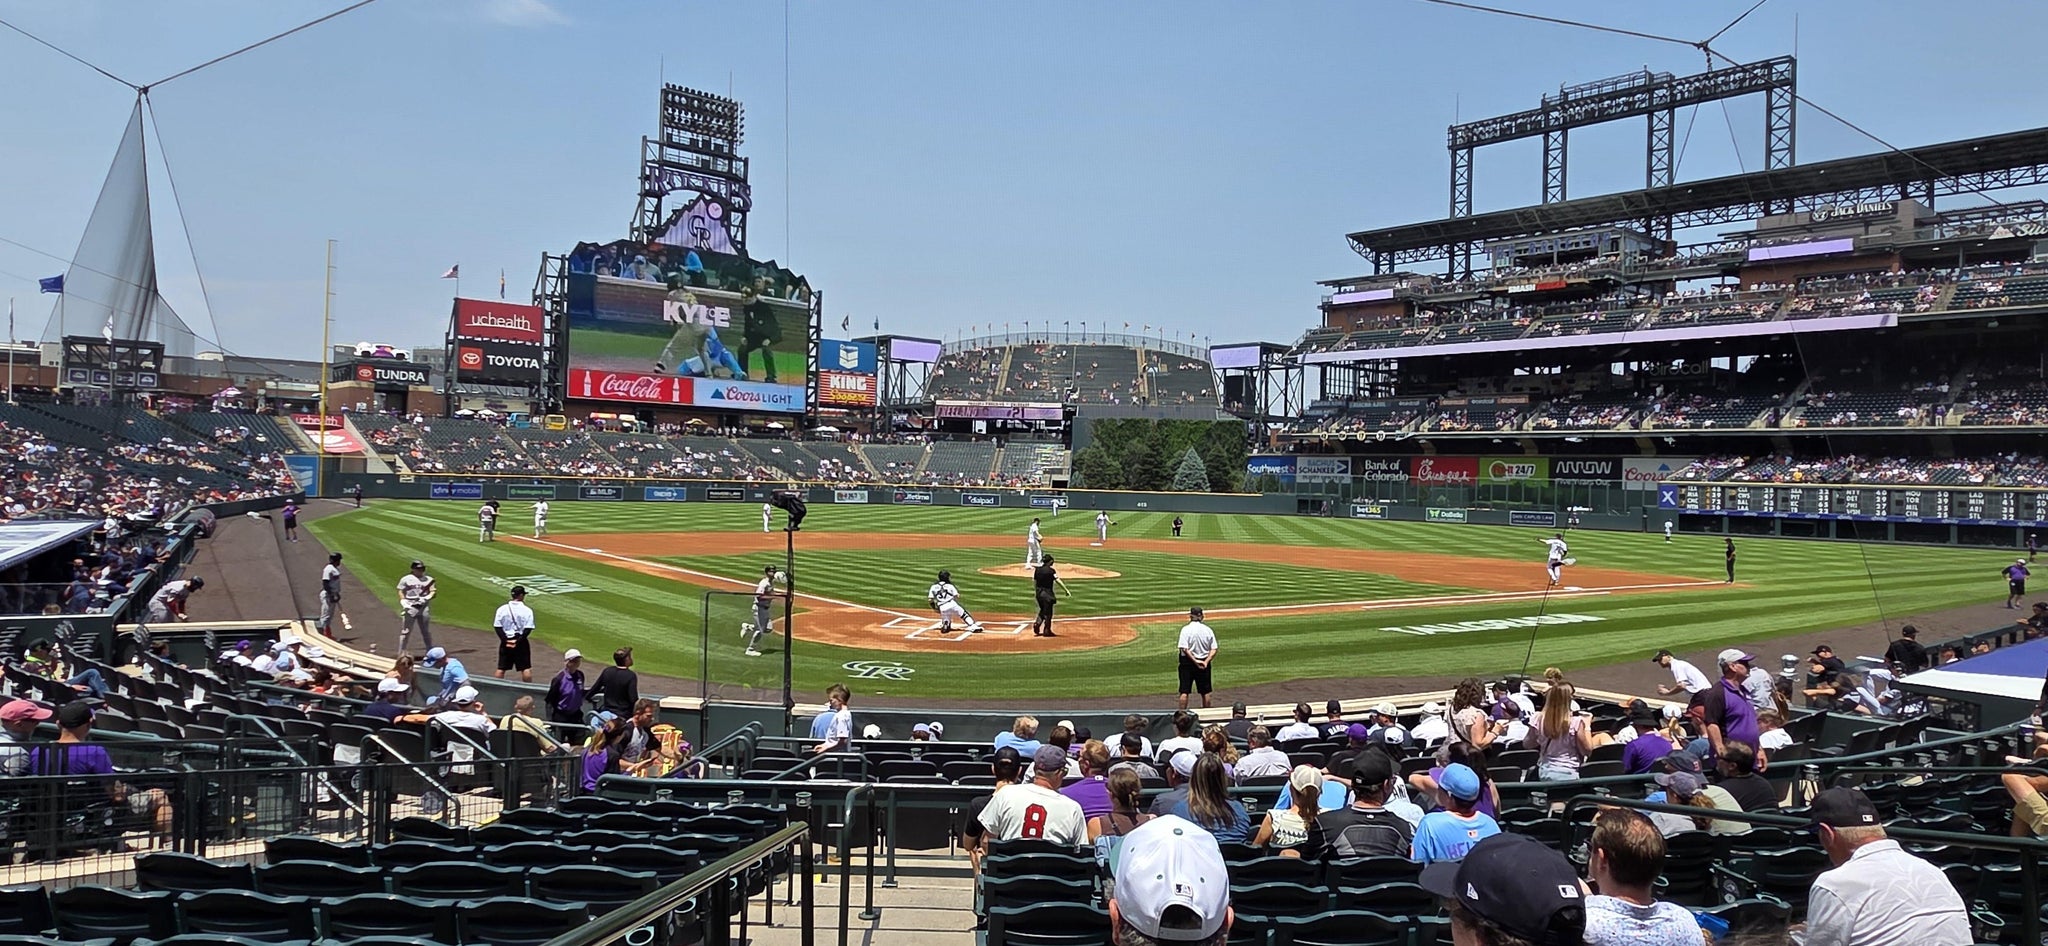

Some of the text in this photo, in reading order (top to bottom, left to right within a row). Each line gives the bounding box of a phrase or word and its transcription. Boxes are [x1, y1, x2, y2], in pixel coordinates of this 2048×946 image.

[1831, 206, 1854, 217] JACK
[663, 301, 730, 327] KYLE
[472, 312, 531, 331] uchealth
[486, 354, 540, 369] TOYOTA
[374, 368, 425, 382] TUNDRA
[600, 373, 664, 399] Coca-Cola
[829, 375, 867, 390] KING
[726, 386, 793, 405] Coors LIGHT
[295, 414, 338, 425] uchelth
[1247, 463, 1289, 474] Southwest
[1365, 460, 1400, 470] Bank of
[1515, 465, 1534, 475] 24/7
[1556, 461, 1612, 474] ARROW
[1365, 470, 1409, 481] Colorado
[1624, 467, 1667, 482] Coors
[970, 496, 994, 505] dialpad
[1357, 506, 1381, 514] bet365
[1021, 803, 1048, 838] 8
